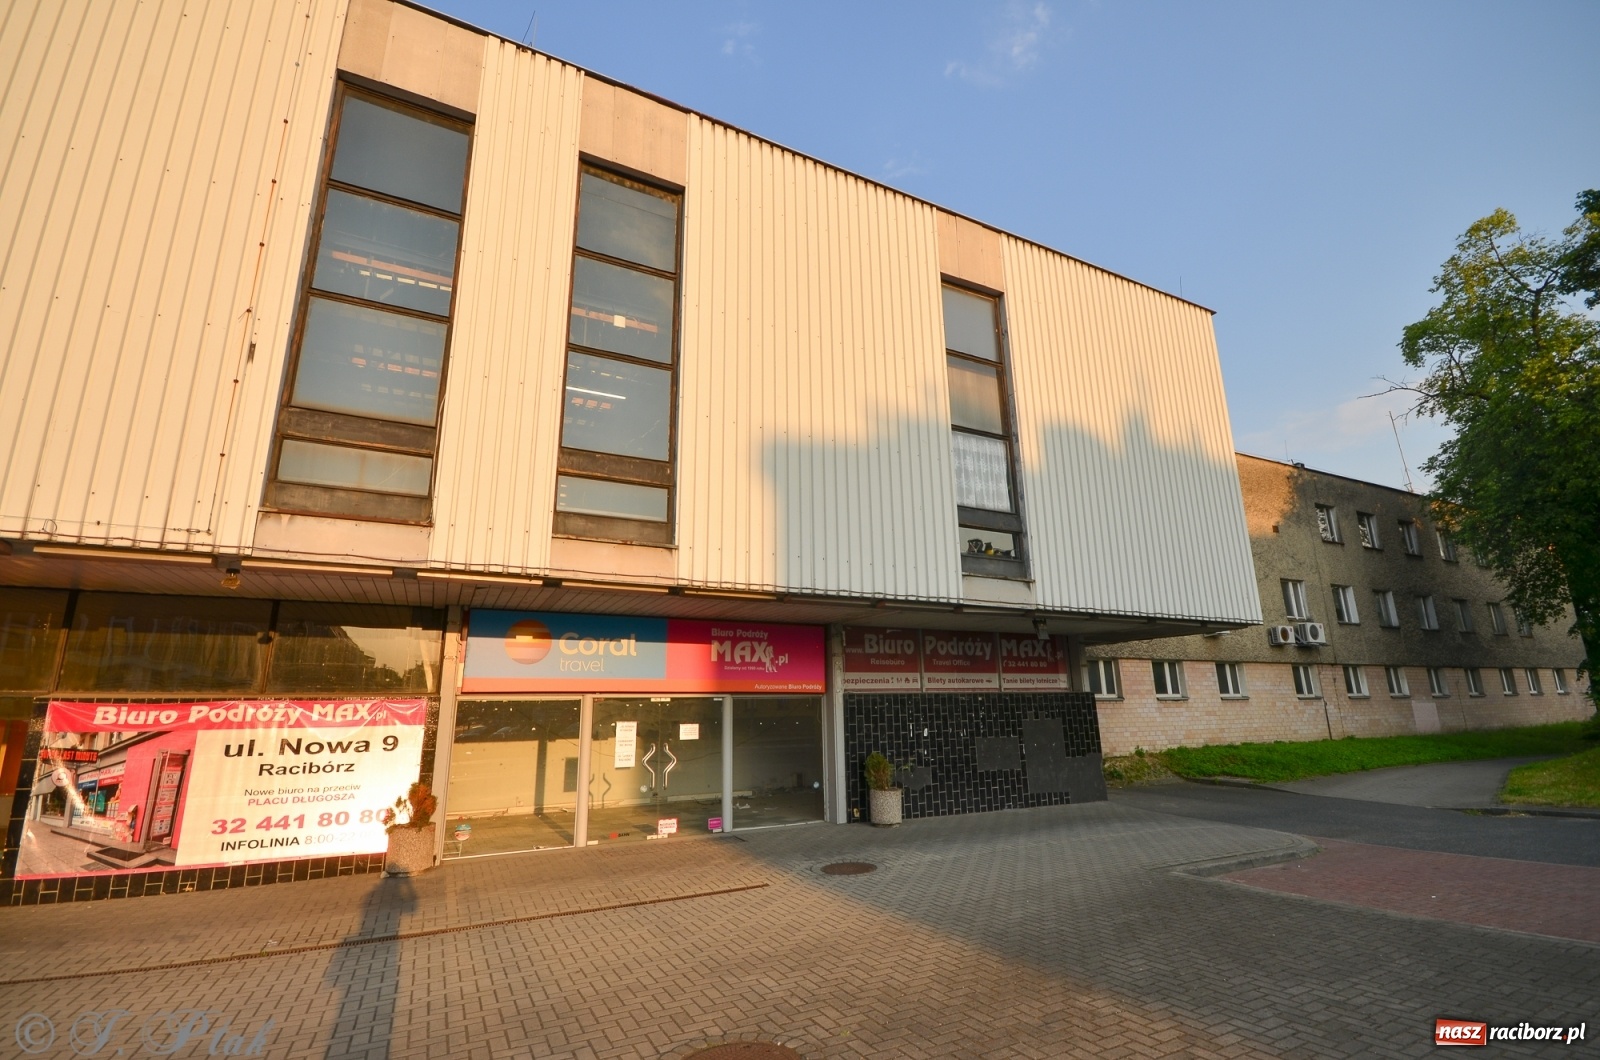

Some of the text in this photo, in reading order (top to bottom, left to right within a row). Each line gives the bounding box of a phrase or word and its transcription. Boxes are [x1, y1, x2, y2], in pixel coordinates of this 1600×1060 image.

[711, 628, 769, 640] Biuro Podróży
[558, 631, 637, 657] Coral
[924, 635, 993, 661] Podróży
[559, 656, 605, 673] travel
[927, 677, 946, 685] Bilety
[93, 705, 178, 727] Biuro
[188, 703, 302, 725] Podróży
[223, 735, 400, 758] ul. Nowa 9
[258, 760, 356, 777] Racibórz
[244, 788, 275, 797] Nowe
[278, 786, 305, 795] biuro
[322, 783, 362, 794] przeciw
[248, 793, 356, 807] PLACU DŁUGOSZA
[211, 818, 247, 835] 32
[254, 813, 306, 833] 441
[317, 811, 350, 827] 80
[220, 837, 300, 852] INFOLINIA
